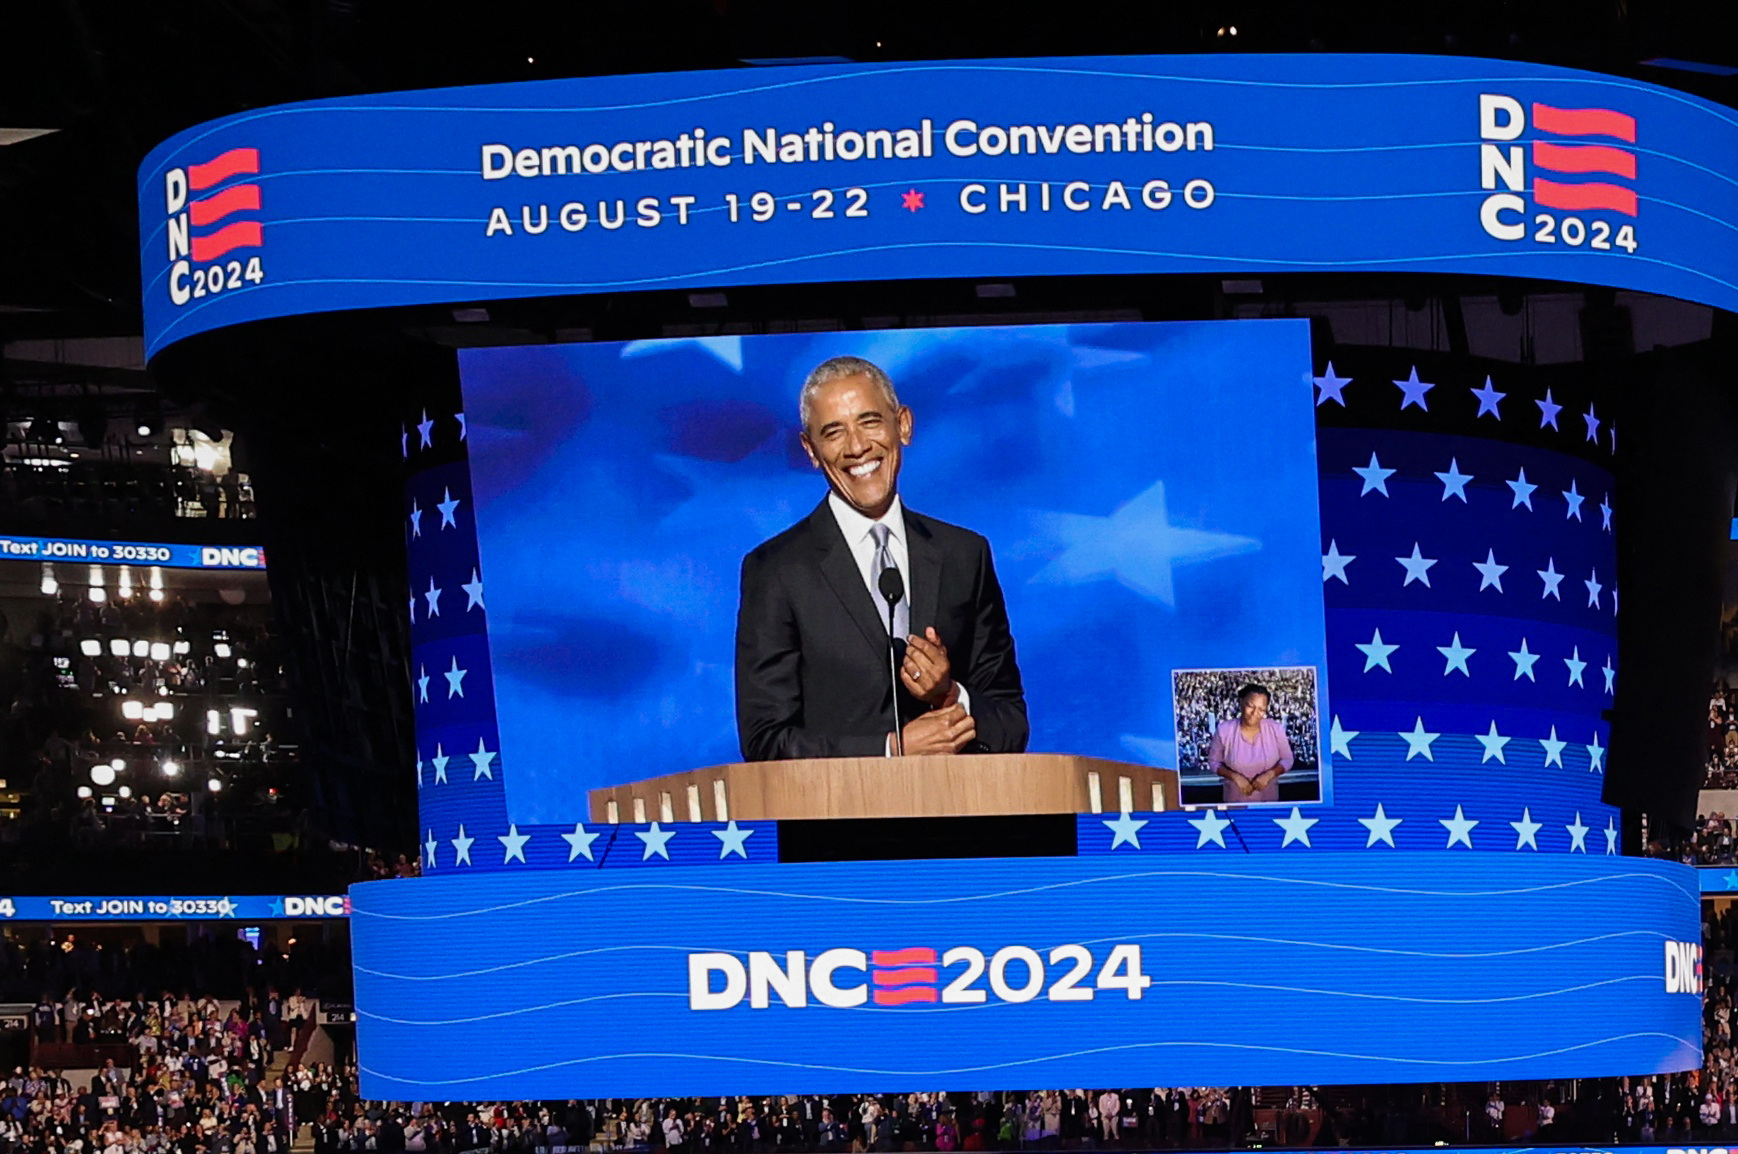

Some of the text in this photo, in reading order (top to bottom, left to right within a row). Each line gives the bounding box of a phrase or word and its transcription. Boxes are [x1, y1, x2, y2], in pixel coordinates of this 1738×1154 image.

[482, 112, 1215, 182] Democratic National Convention
[486, 179, 1216, 238] AUGUST 19-22 CHICAGO
[1533, 213, 1638, 254] 2024
[193, 257, 264, 300] 2024
[0, 540, 38, 555] Text
[41, 542, 87, 557] JOIN
[90, 545, 110, 559] to
[113, 545, 170, 561] 30330
[50, 900, 92, 914] Text
[96, 900, 144, 915] JOIN
[147, 900, 168, 914] to
[170, 900, 231, 915] 30330
[942, 943, 1151, 1004] 2024
